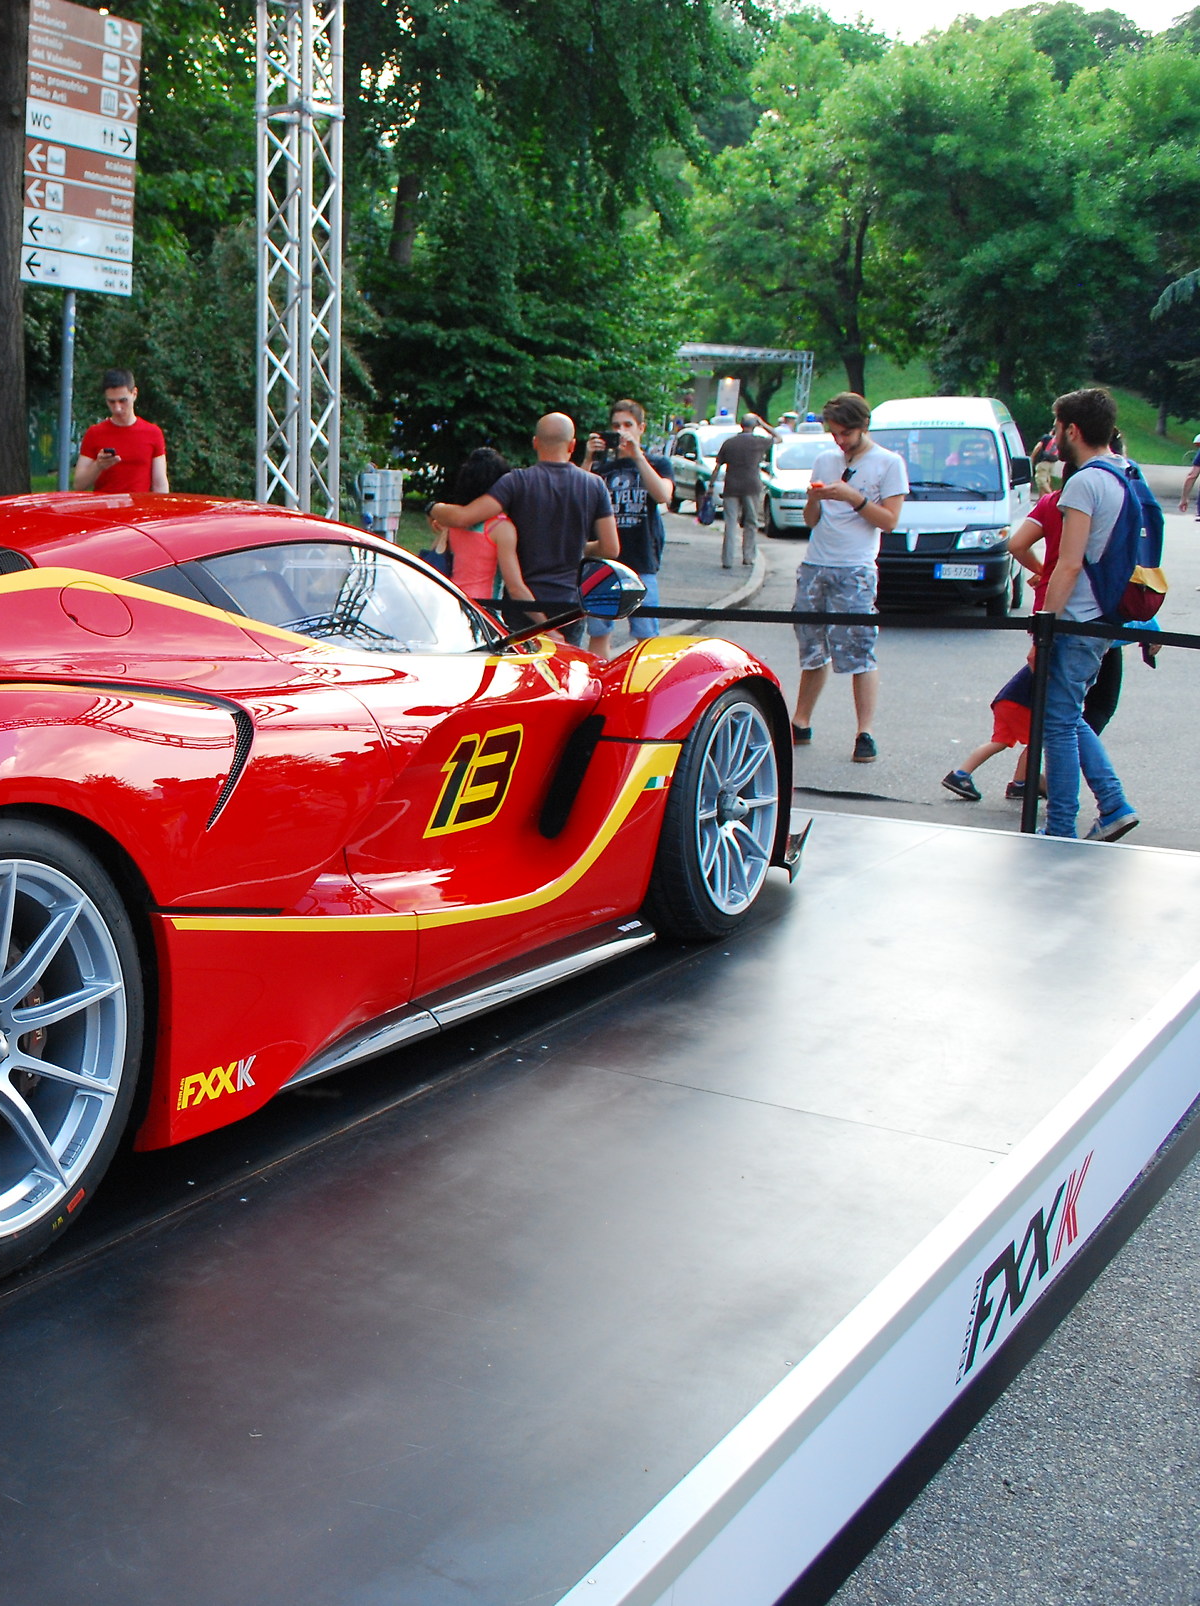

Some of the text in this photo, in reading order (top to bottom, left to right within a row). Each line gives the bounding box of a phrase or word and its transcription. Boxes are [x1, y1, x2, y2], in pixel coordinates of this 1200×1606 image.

[33, 11, 67, 30] botanico
[32, 34, 64, 50] castello
[31, 49, 82, 70] del Valentino
[51, 90, 67, 104] Arti
[32, 112, 52, 130] WC
[83, 170, 132, 188] monumentale
[911, 419, 964, 427] elettrica
[422, 722, 524, 839] 13
[955, 1275, 983, 1385] FERRARI
